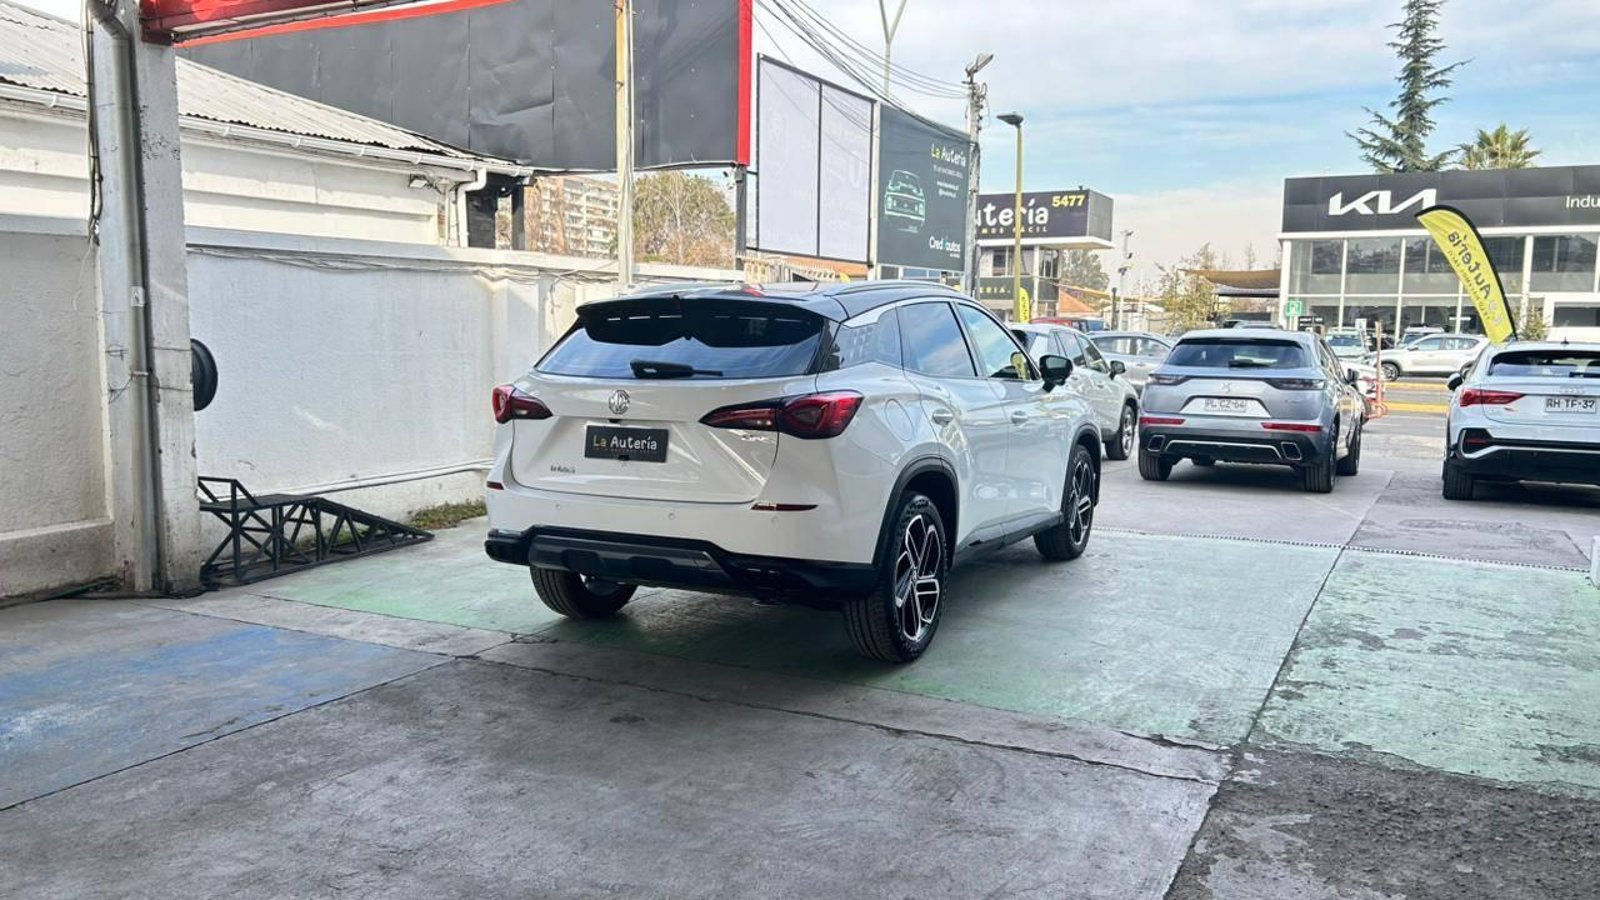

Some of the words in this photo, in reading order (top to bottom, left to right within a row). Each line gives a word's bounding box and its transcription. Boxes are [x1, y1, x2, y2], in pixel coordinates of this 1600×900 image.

[1052, 194, 1085, 207] 5477
[1328, 188, 1438, 216] KIA
[1546, 398, 1561, 408] RH
[593, 434, 606, 448] La
[610, 435, 657, 451] Autería
